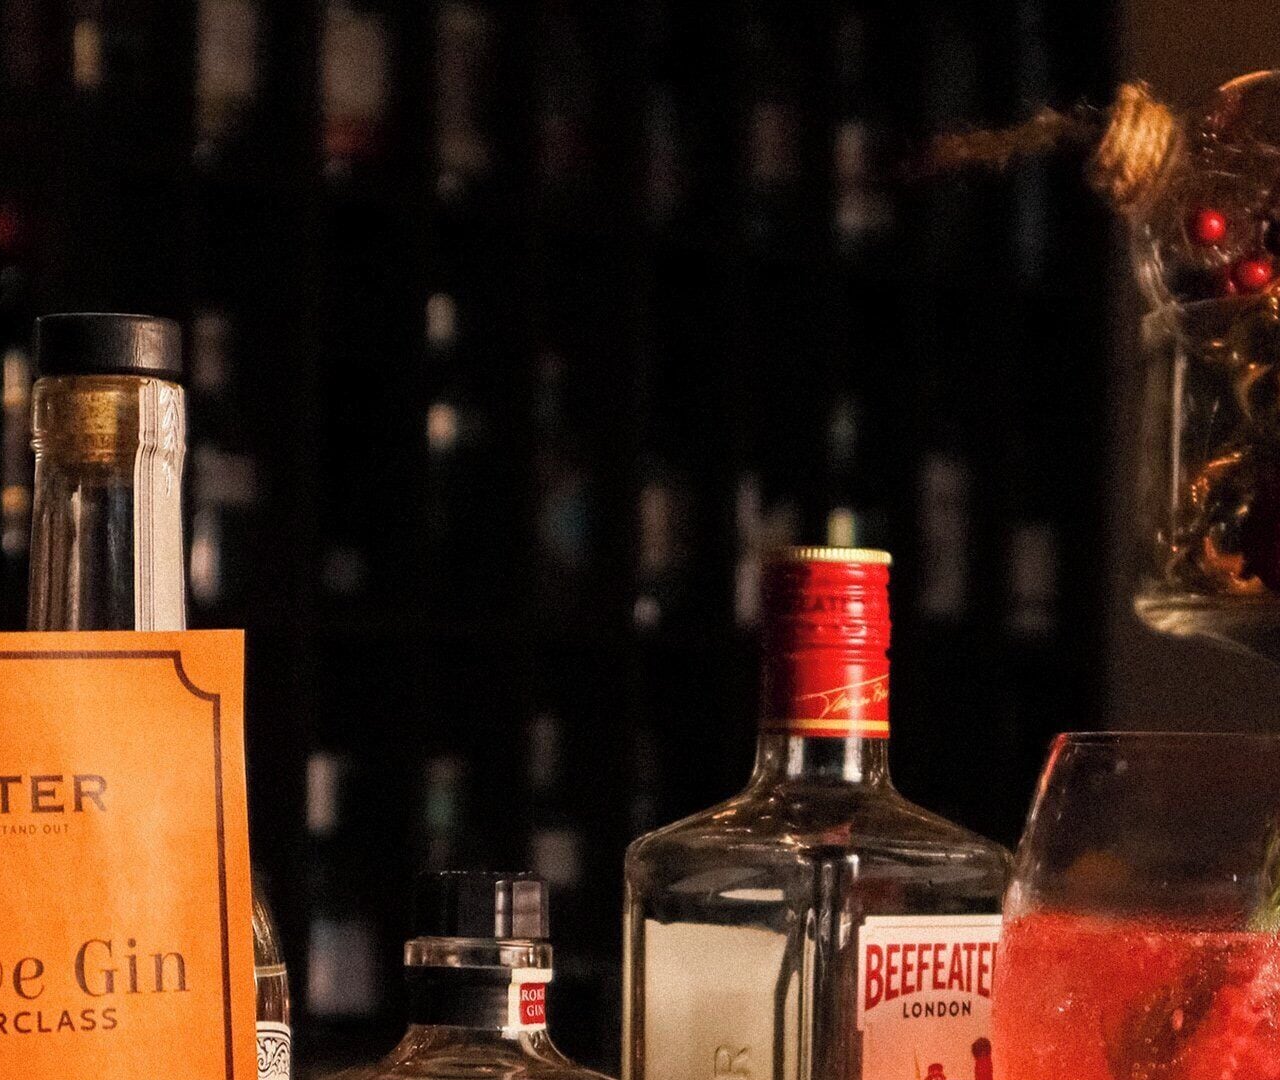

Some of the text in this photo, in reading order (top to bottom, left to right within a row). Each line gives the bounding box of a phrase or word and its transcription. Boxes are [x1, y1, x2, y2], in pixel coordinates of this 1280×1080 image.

[43, 823, 70, 835] OUT
[74, 937, 191, 998] Gin
[902, 999, 972, 1019] LONDON
